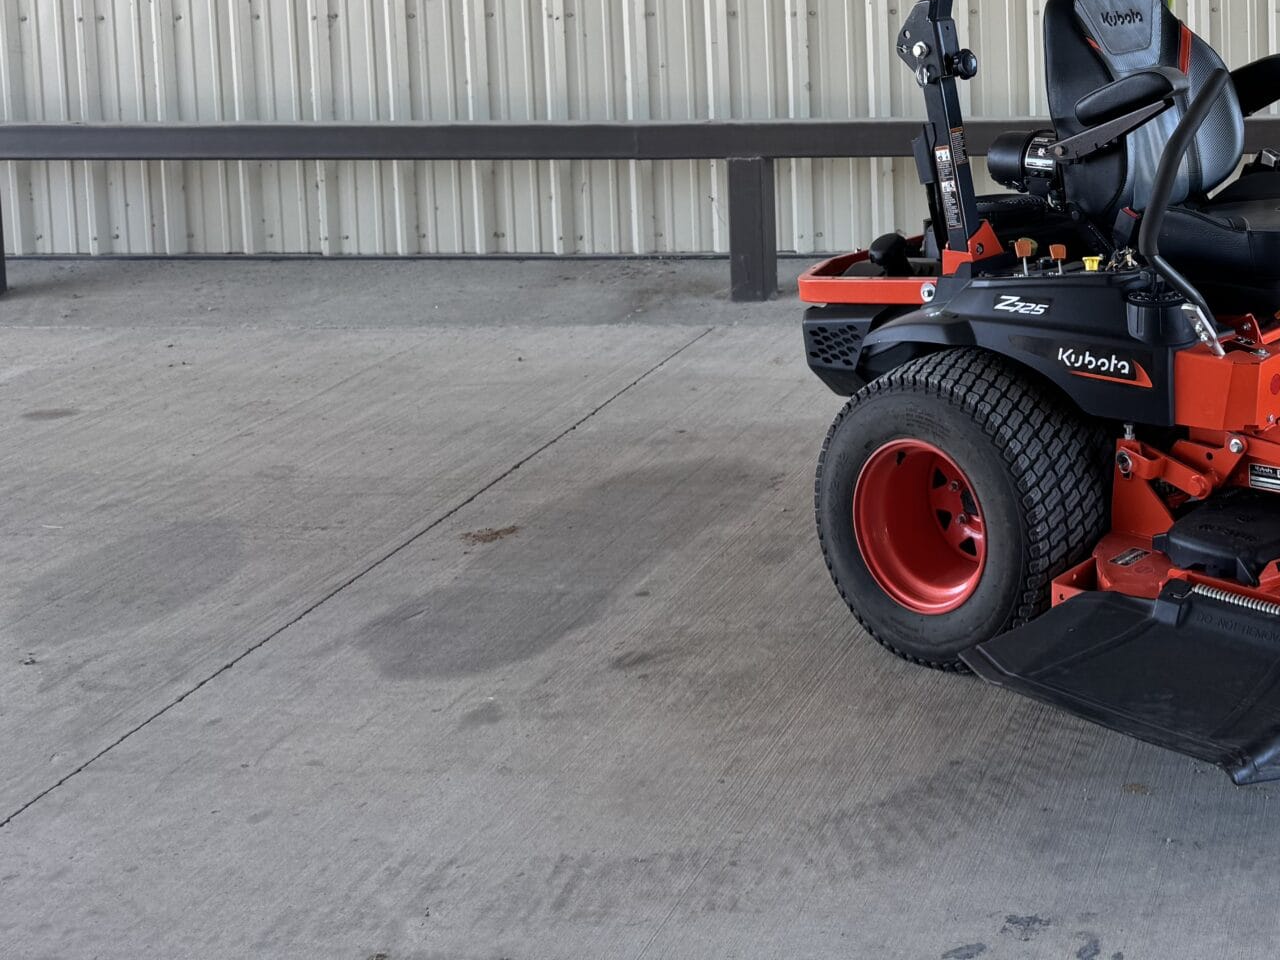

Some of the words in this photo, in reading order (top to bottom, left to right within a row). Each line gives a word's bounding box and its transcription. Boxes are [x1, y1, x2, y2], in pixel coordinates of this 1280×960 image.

[1101, 9, 1143, 27] Kubota
[994, 295, 1049, 315] Z725
[1058, 347, 1129, 374] Kubota
